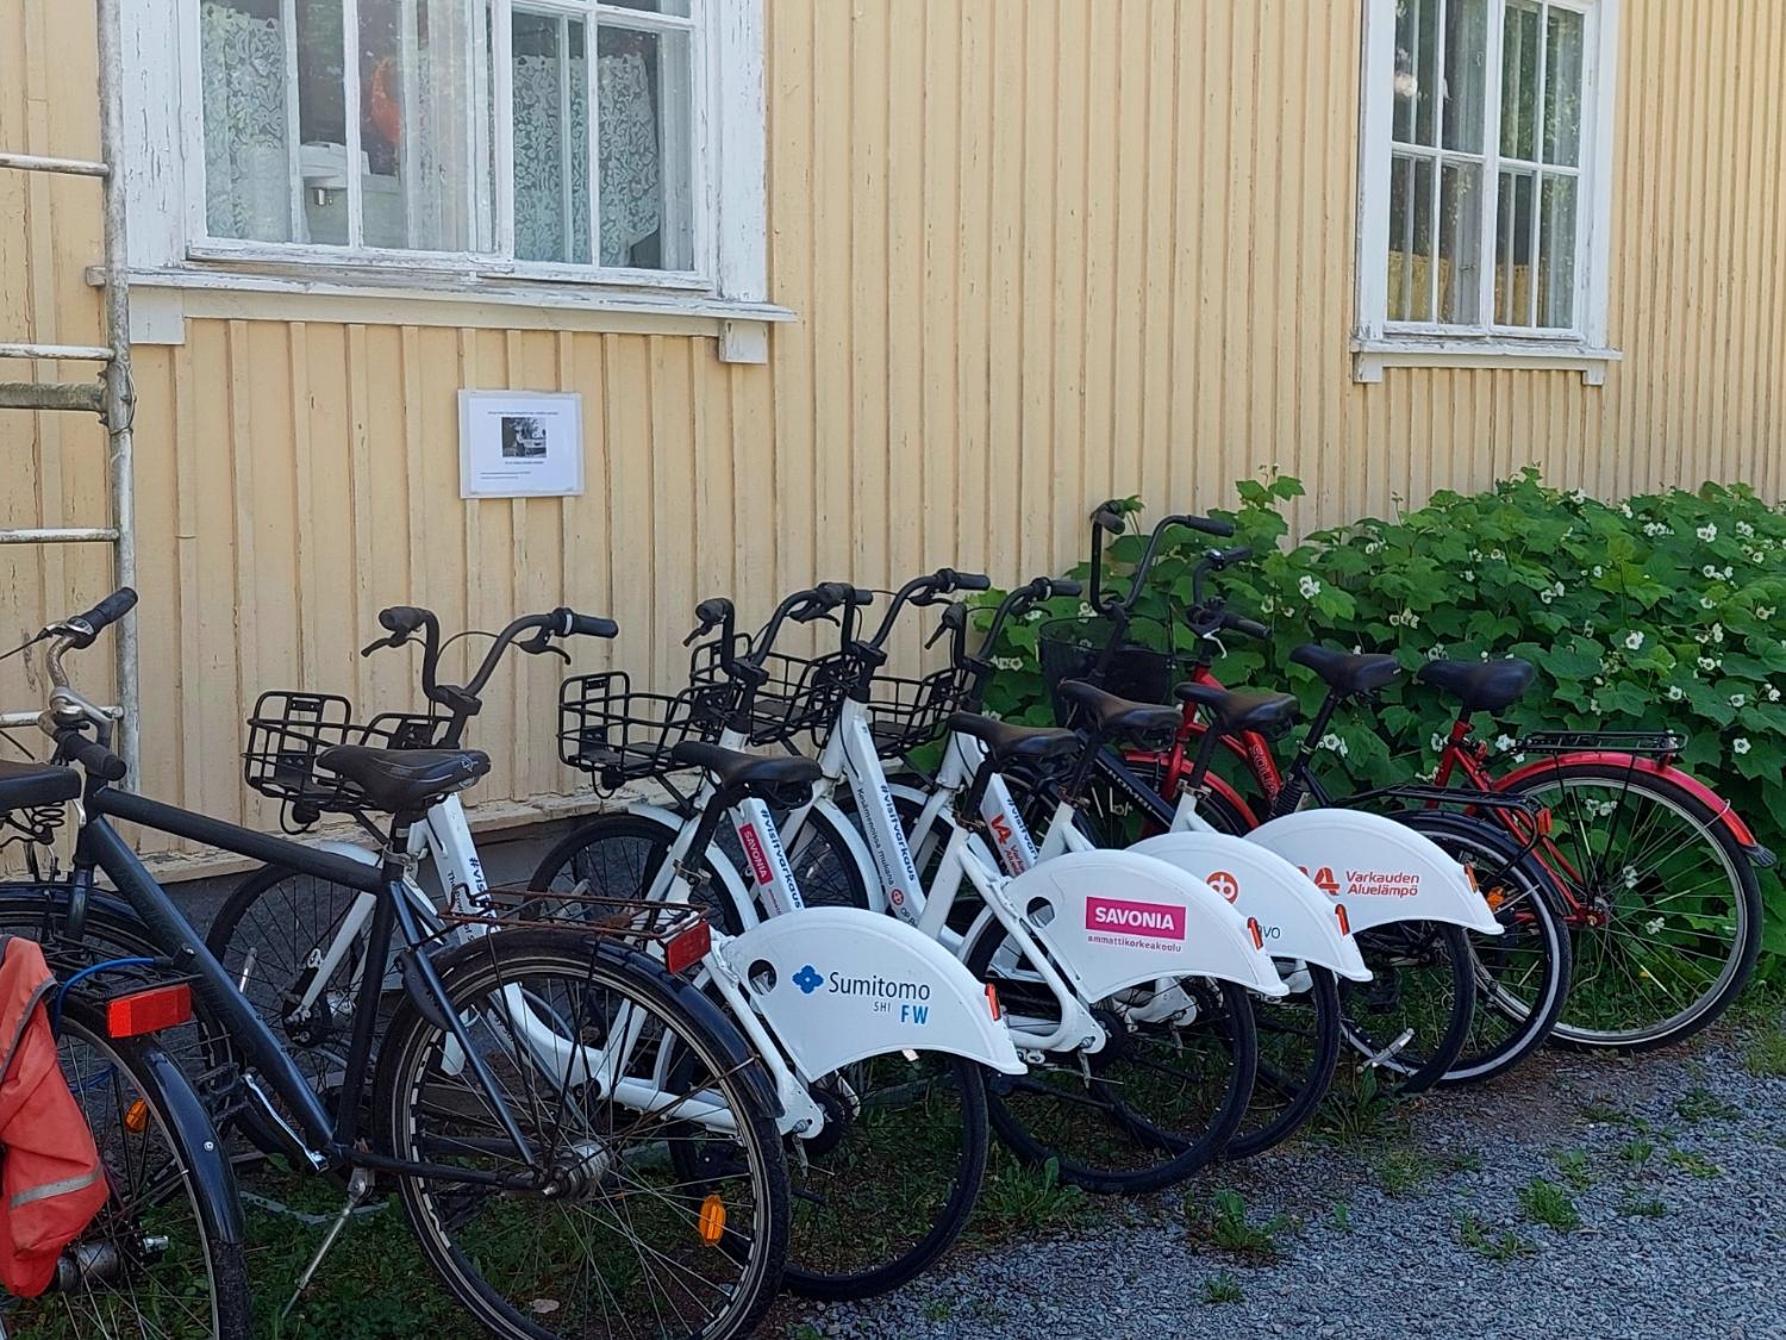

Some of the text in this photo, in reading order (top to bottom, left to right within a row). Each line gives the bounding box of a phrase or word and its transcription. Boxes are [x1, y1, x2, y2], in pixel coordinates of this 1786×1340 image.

[743, 831, 767, 878] SAVONIA
[760, 809, 801, 909] #visitvarkaus
[1346, 870, 1420, 884] Varkauden
[1347, 884, 1418, 898] Aluelämpö
[1095, 906, 1175, 931] SAVONIA
[1087, 935, 1182, 952] ammattikorkeakoulu
[828, 971, 931, 1001] Sumitomo
[873, 1001, 928, 1025] SHI FW
